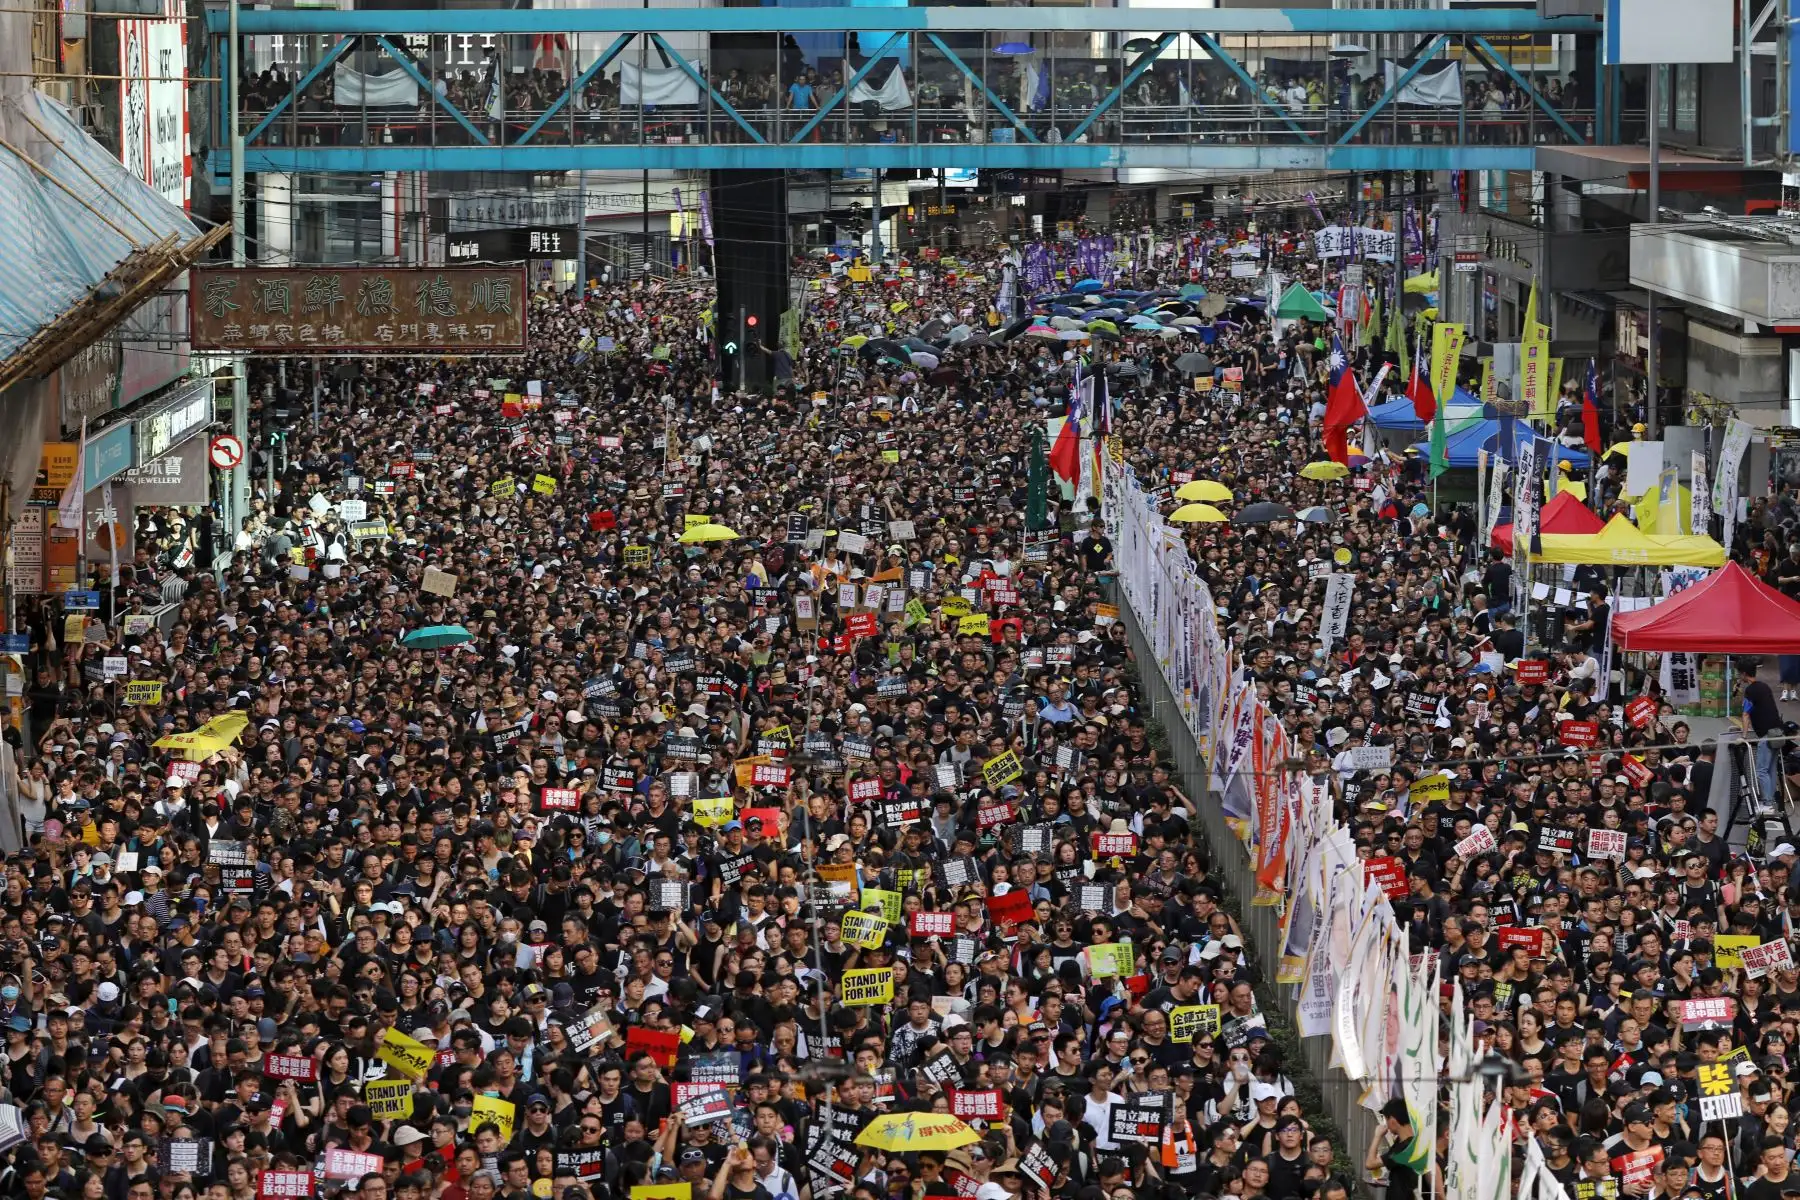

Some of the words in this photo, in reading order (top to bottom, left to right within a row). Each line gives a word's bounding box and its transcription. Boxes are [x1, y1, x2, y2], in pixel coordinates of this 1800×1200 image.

[159, 49, 172, 84] KFC
[529, 231, 561, 252] 周生生
[138, 477, 182, 485] JEWELLERY
[39, 490, 57, 499] 3521
[841, 588, 854, 602] 放
[867, 589, 881, 603] 義
[891, 593, 904, 606] 士
[798, 600, 811, 613] 釋
[128, 684, 148, 692] STAND
[149, 684, 160, 692] UP
[128, 692, 141, 701] FOR
[757, 740, 786, 748] 獨立調查
[604, 769, 634, 779] 獨立調查
[545, 789, 576, 798] 全面撤回
[546, 797, 576, 807] 送中惡法
[885, 801, 918, 812] 獨立調查
[977, 805, 1008, 821] 全面撤回
[1540, 827, 1574, 840] 獨立調查
[1591, 831, 1625, 843] 相信青年
[1099, 836, 1132, 845] 全面撤回
[1590, 840, 1625, 854] 相信人民
[1099, 844, 1132, 854] 送中惡法
[719, 855, 753, 873] 獨立調查
[222, 869, 252, 879] 獨立調查
[843, 916, 869, 929] STAND
[873, 920, 886, 931] UP
[915, 914, 952, 924] 全面撤回
[842, 928, 855, 938] FOR
[915, 923, 951, 933] 送中惡法
[1742, 942, 1783, 960] 相信青年
[1744, 952, 1788, 970] 相信人民
[845, 975, 874, 987] STAND
[877, 971, 891, 983] UP
[845, 987, 862, 998] FOR
[1686, 999, 1726, 1010] 全面撤回
[1172, 1008, 1217, 1026] 企硬立場
[1686, 1007, 1727, 1019] 送中惡法
[565, 1009, 604, 1037] 獨立調查
[268, 1055, 311, 1069] 全面撤回
[268, 1066, 312, 1080] 送中惡法
[366, 1066, 386, 1076] NIKE
[691, 1065, 738, 1076] 追究警察暴行
[1698, 1064, 1734, 1095] 柒
[368, 1086, 395, 1100] STAND
[396, 1083, 410, 1097] UP
[676, 1084, 720, 1096] 全面撤回
[679, 1093, 724, 1110] 獨立調查
[954, 1092, 997, 1104] 全面撤回
[369, 1101, 384, 1114] FOR
[954, 1104, 998, 1115] 送中惡法
[1114, 1109, 1160, 1123] 獨立調查
[557, 1152, 601, 1165] 獨立調查
[821, 1140, 859, 1166] 獨立調查
[1029, 1143, 1060, 1178] 獨立調查
[263, 1172, 310, 1186] 全面撤回
[263, 1185, 310, 1198] 送中惡法
